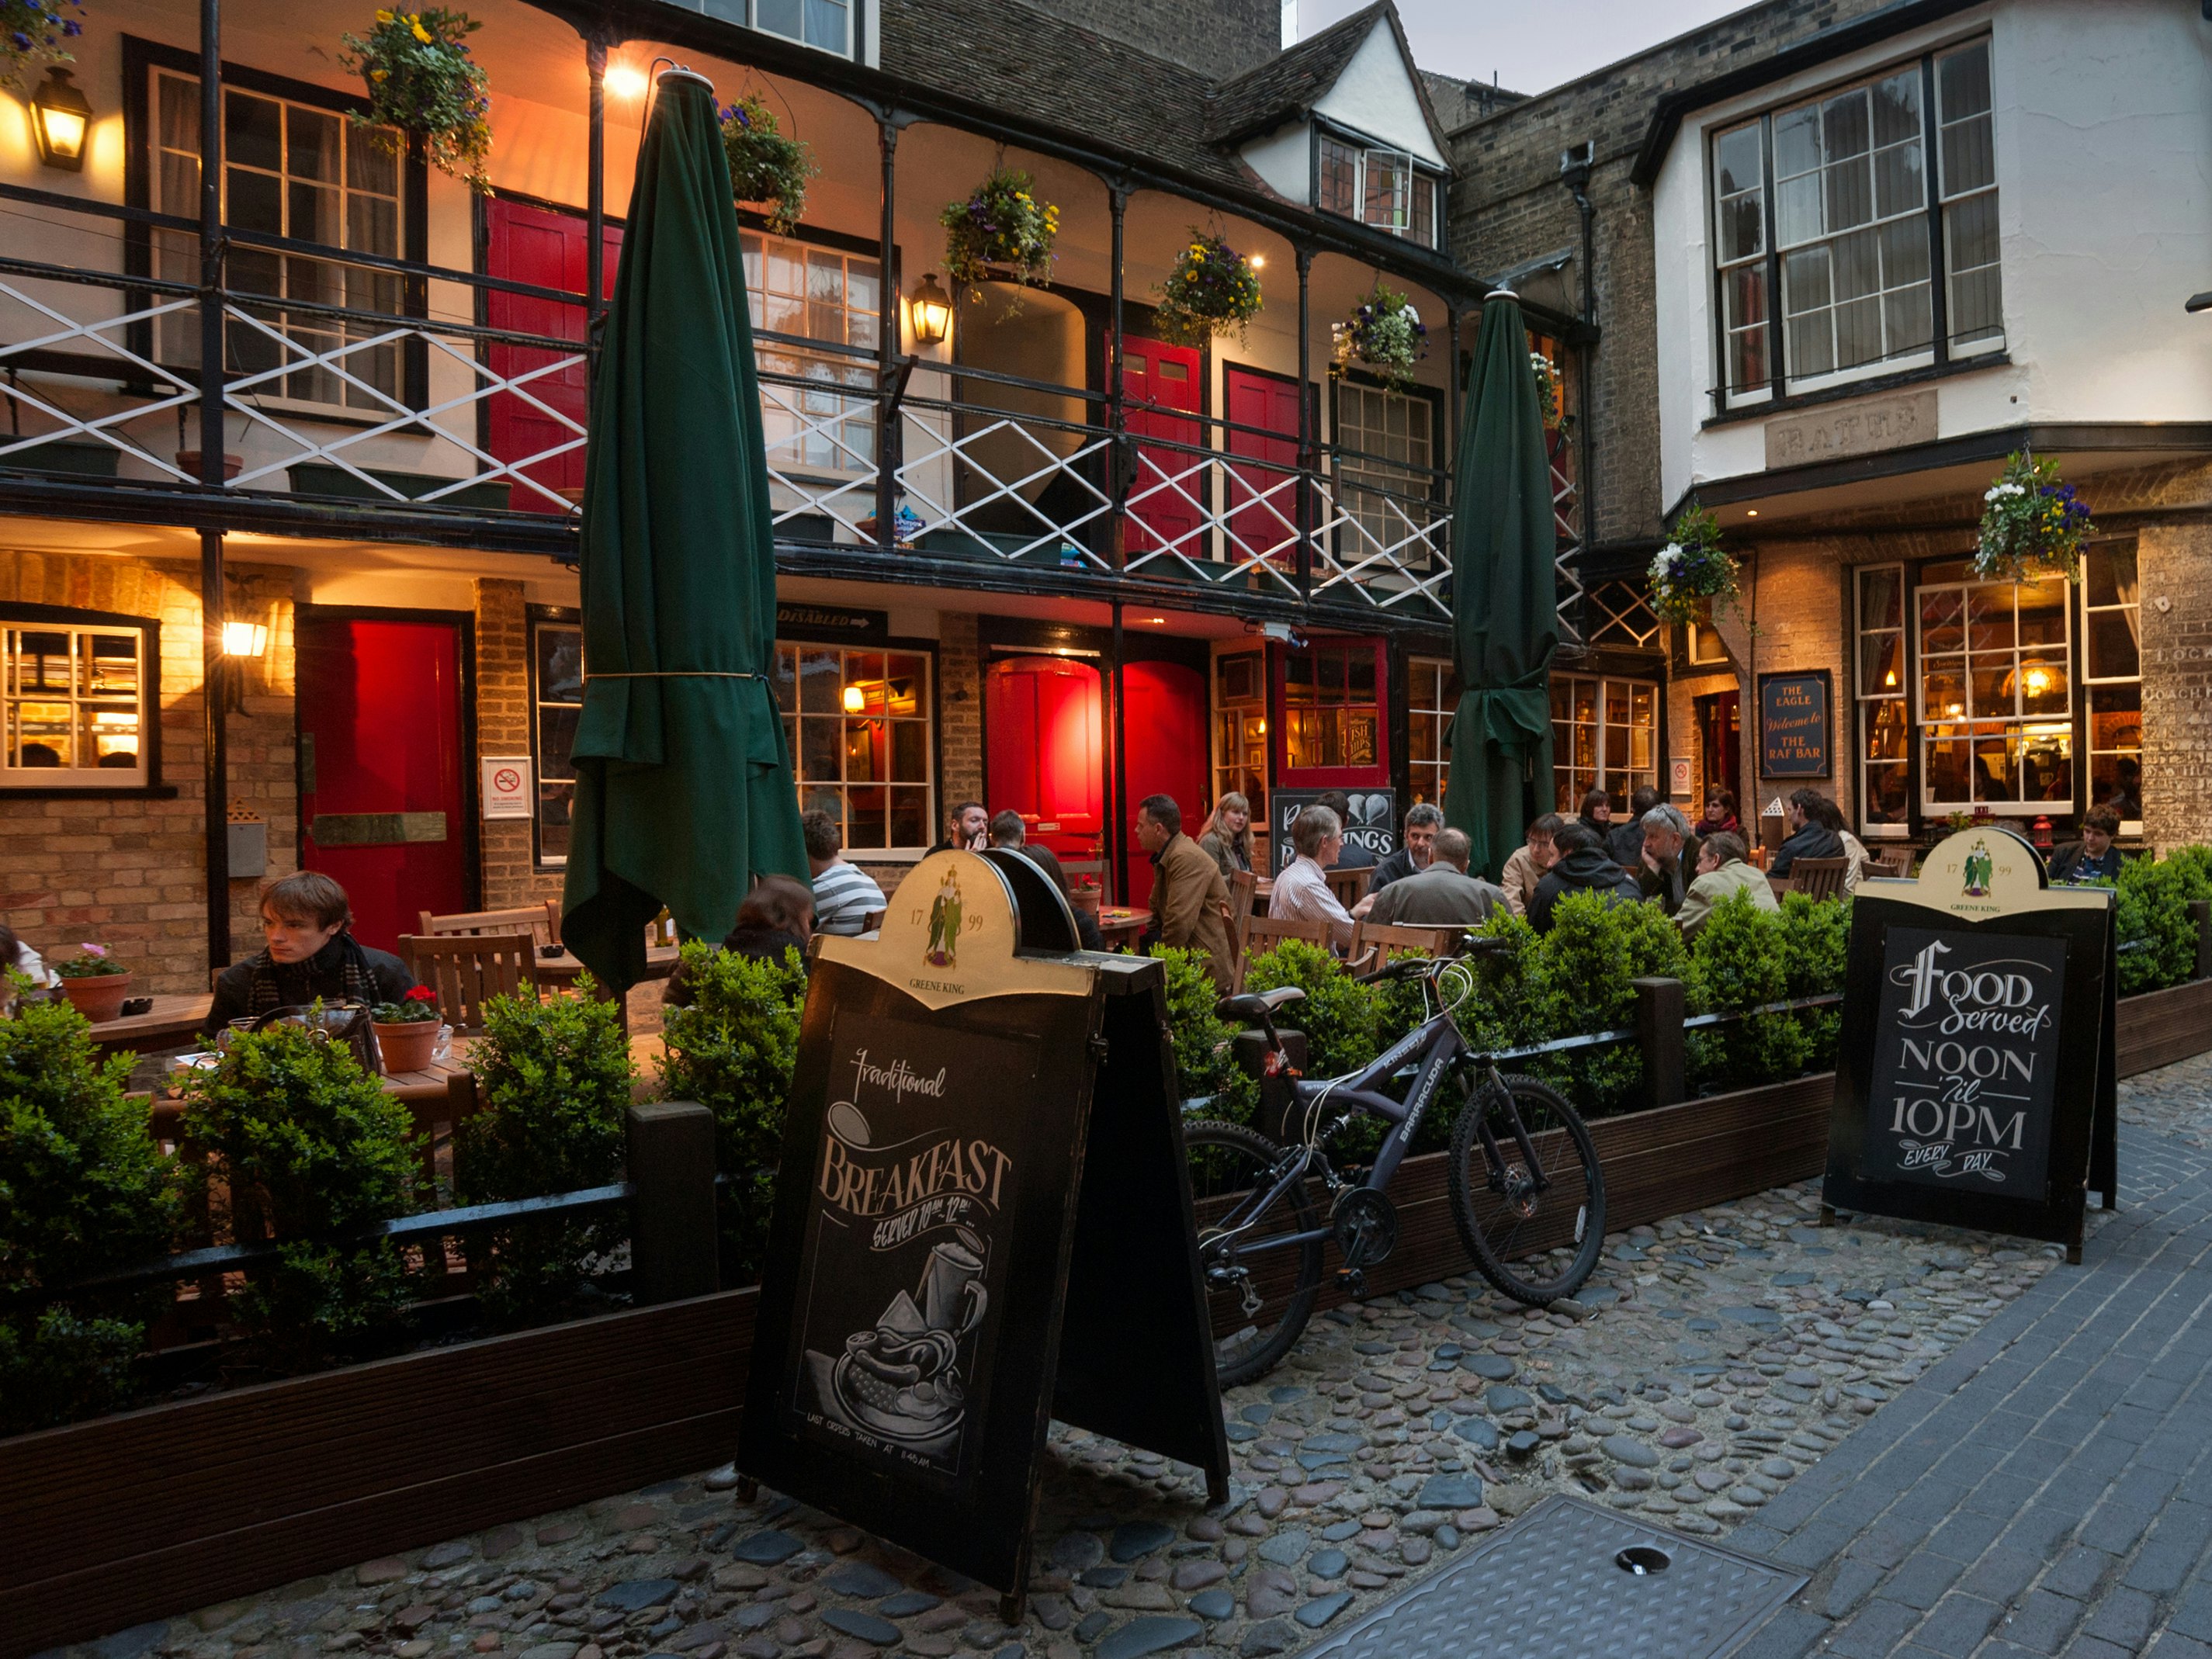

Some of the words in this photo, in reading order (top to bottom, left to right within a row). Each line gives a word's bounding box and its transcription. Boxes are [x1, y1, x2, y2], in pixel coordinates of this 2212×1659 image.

[1775, 404, 1918, 458] BATHS
[777, 608, 850, 626] DISABLED
[1775, 695, 1812, 707] EAGLE
[1782, 685, 1802, 696] THE
[1766, 716, 1809, 733] Welcome
[1811, 711, 1822, 724] to
[1769, 748, 1792, 760] RAF
[1795, 746, 1821, 759] BAR
[1780, 736, 1806, 748] THE
[1947, 864, 1958, 874] 17
[1999, 866, 2013, 876] 99
[910, 909, 924, 926] 17
[969, 914, 983, 932] 99
[909, 978, 941, 992] GREENE
[941, 982, 966, 996] KING
[1898, 939, 2033, 1020] FOOD
[1940, 993, 2050, 1042] Served
[849, 1048, 946, 1104] Traditional
[1898, 1037, 2037, 1083] NOON
[1399, 1058, 1444, 1143] BARRACUDA
[1889, 1096, 2027, 1151] 10PM
[1904, 1145, 1950, 1166] EVERY
[818, 1134, 1012, 1217] BREAKFAST
[873, 1207, 919, 1248] SERVED
[806, 1412, 823, 1426] LAST
[826, 1421, 851, 1437] ORDERS
[855, 1431, 878, 1448] TAKEN
[882, 1444, 895, 1455] AT
